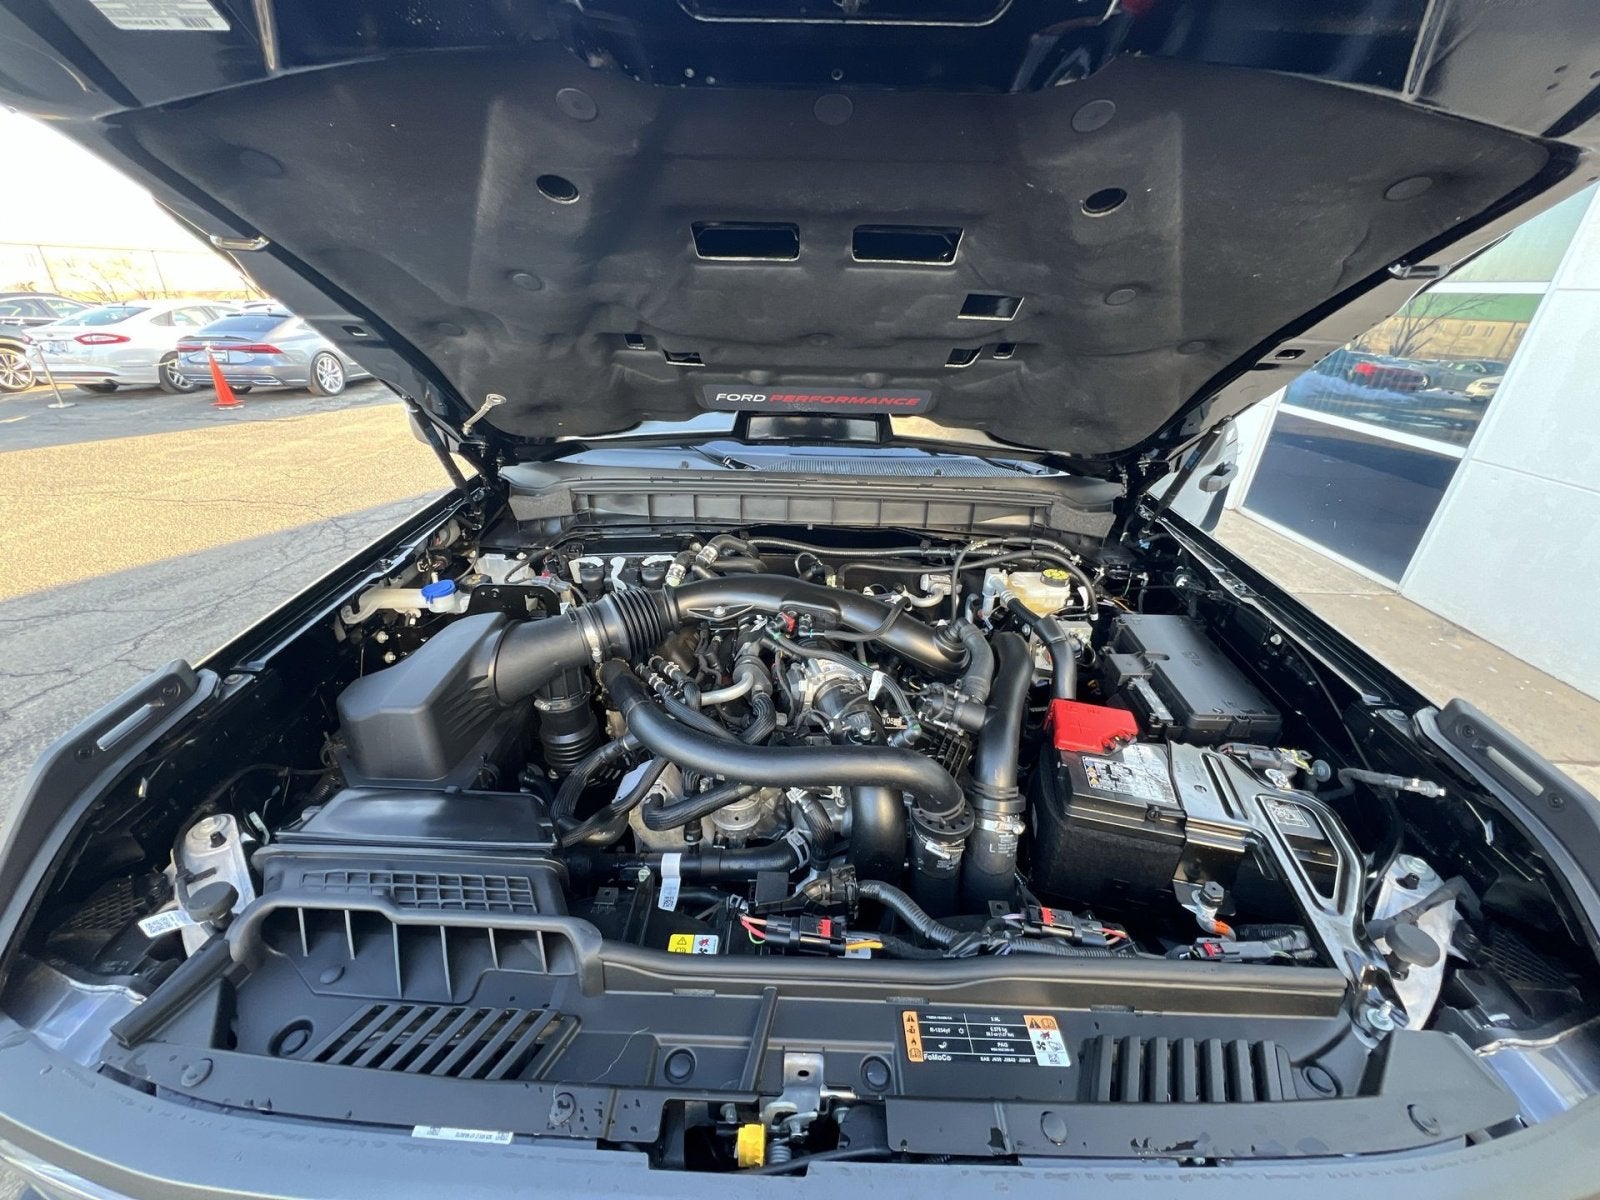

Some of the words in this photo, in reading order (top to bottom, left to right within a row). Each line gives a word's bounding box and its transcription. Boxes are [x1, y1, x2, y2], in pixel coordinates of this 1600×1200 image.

[715, 393, 766, 403] FORD
[769, 393, 921, 407] PERFORMANCE
[923, 1053, 952, 1061] FoMoCo
